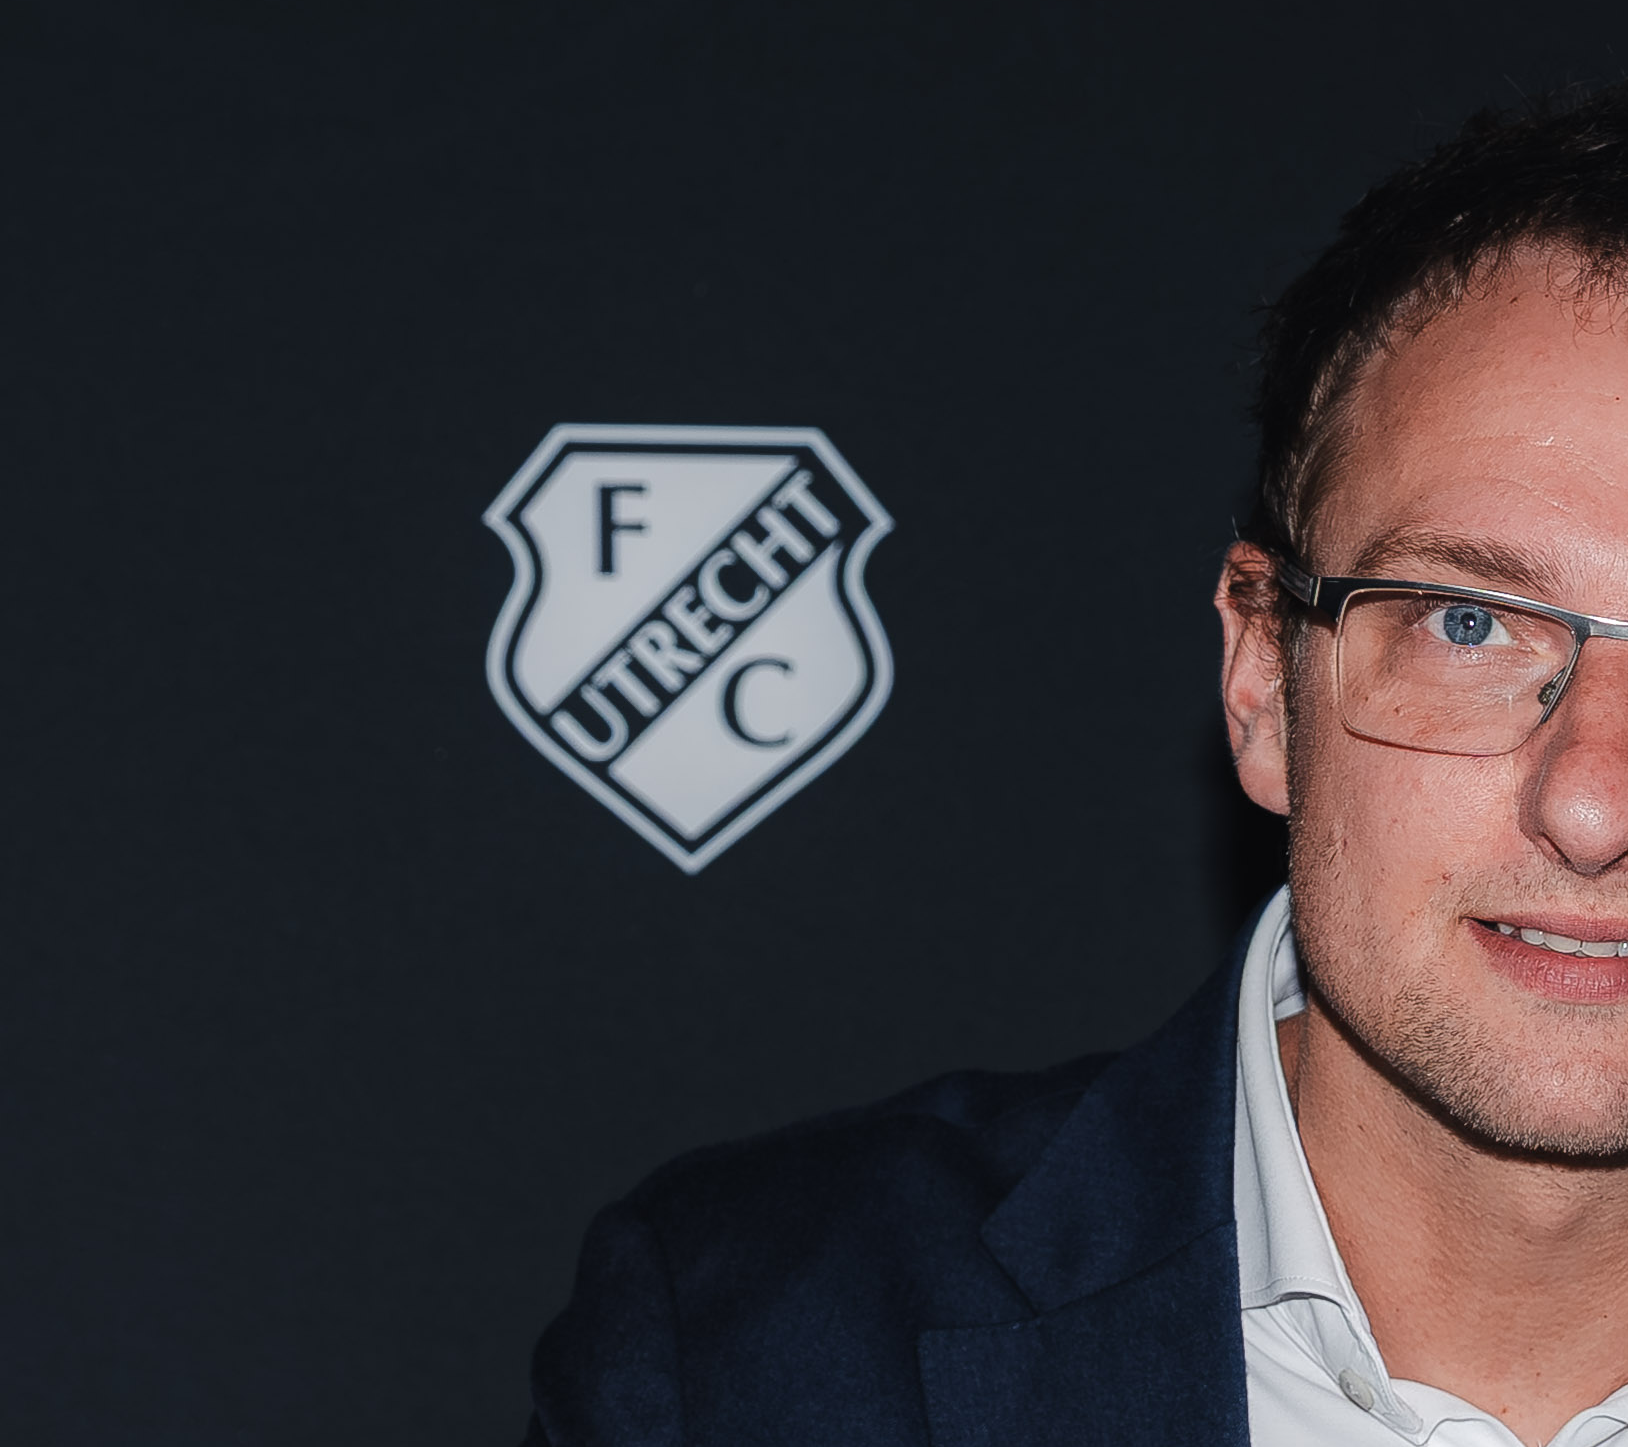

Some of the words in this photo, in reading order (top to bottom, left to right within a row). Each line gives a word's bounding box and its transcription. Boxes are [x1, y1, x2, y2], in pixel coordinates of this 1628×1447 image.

[594, 481, 649, 577] F
[549, 469, 842, 763] UTRECHT
[718, 657, 795, 749] C
